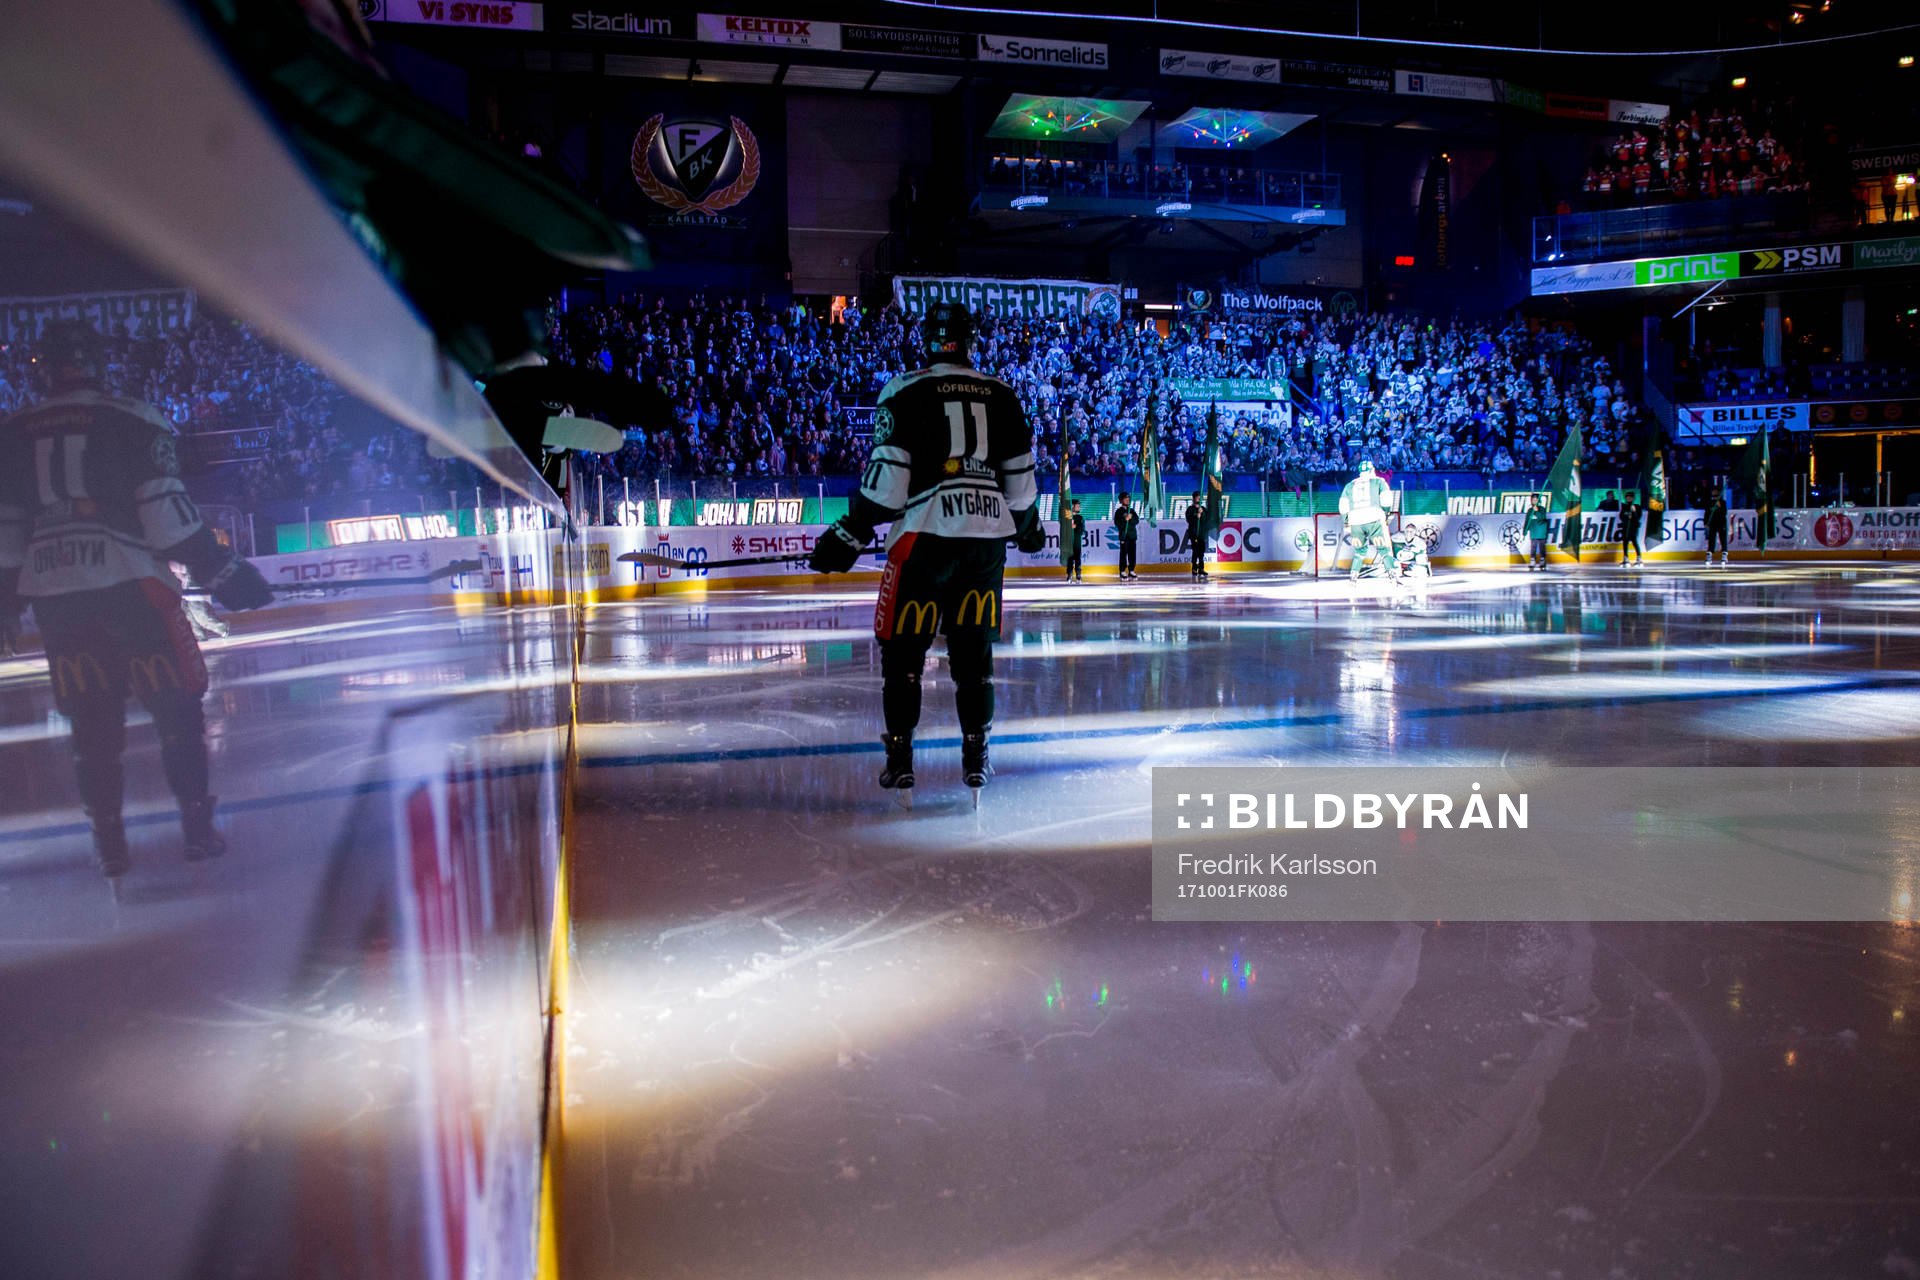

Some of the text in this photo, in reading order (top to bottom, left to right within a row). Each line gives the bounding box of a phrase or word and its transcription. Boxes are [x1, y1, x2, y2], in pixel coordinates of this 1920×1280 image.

[449, 3, 514, 25] SYNS
[570, 9, 673, 36] stadium
[725, 16, 811, 36] KELTOX
[1006, 41, 1106, 66] Sonnelids
[1783, 244, 1842, 268] PSM
[1648, 255, 1728, 284] print
[1221, 293, 1324, 313] The Wolfpack
[936, 383, 992, 396] LÖFBERGS
[1713, 405, 1797, 422] BILLES
[943, 400, 990, 462] 11
[696, 502, 750, 526] JOHAN
[941, 490, 1001, 519] NYGÅRD
